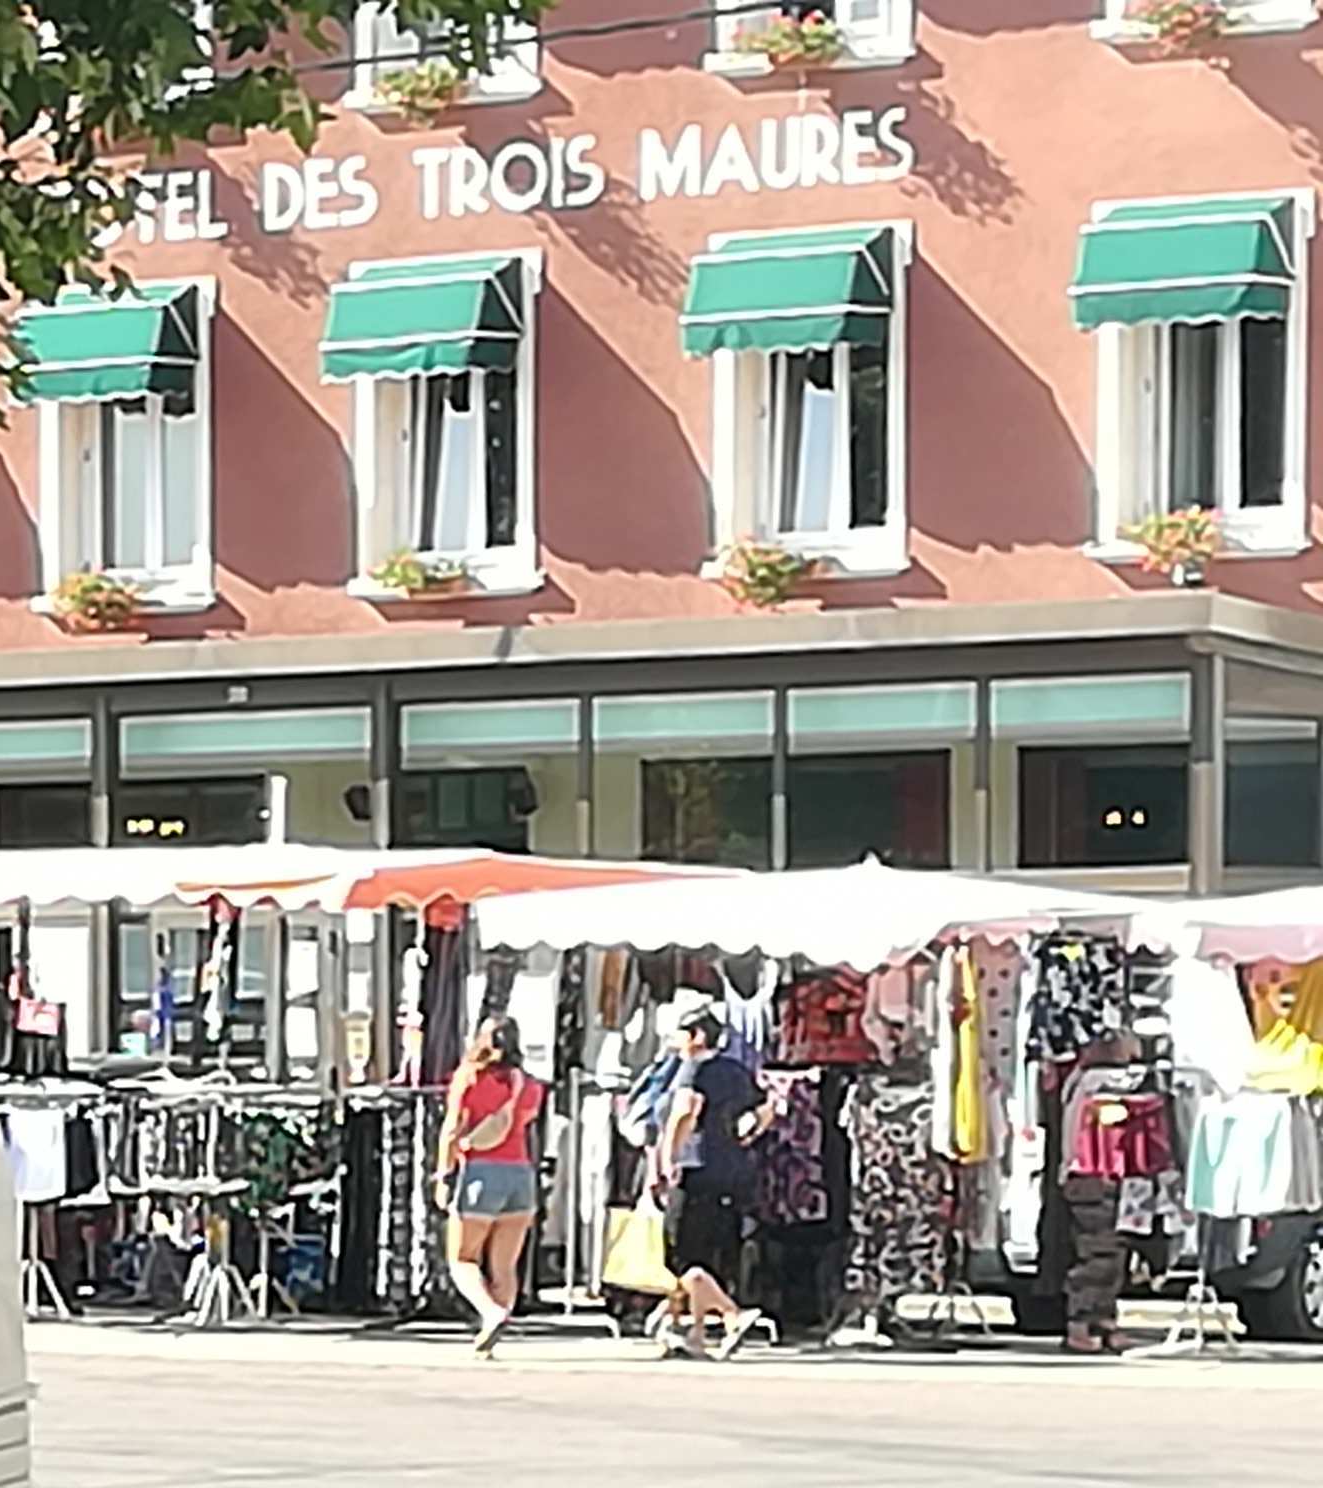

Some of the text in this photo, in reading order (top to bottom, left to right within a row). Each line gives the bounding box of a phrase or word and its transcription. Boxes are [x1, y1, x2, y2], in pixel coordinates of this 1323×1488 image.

[261, 154, 378, 233] DES
[411, 132, 606, 220] TROIS
[637, 106, 915, 203] MAURES
